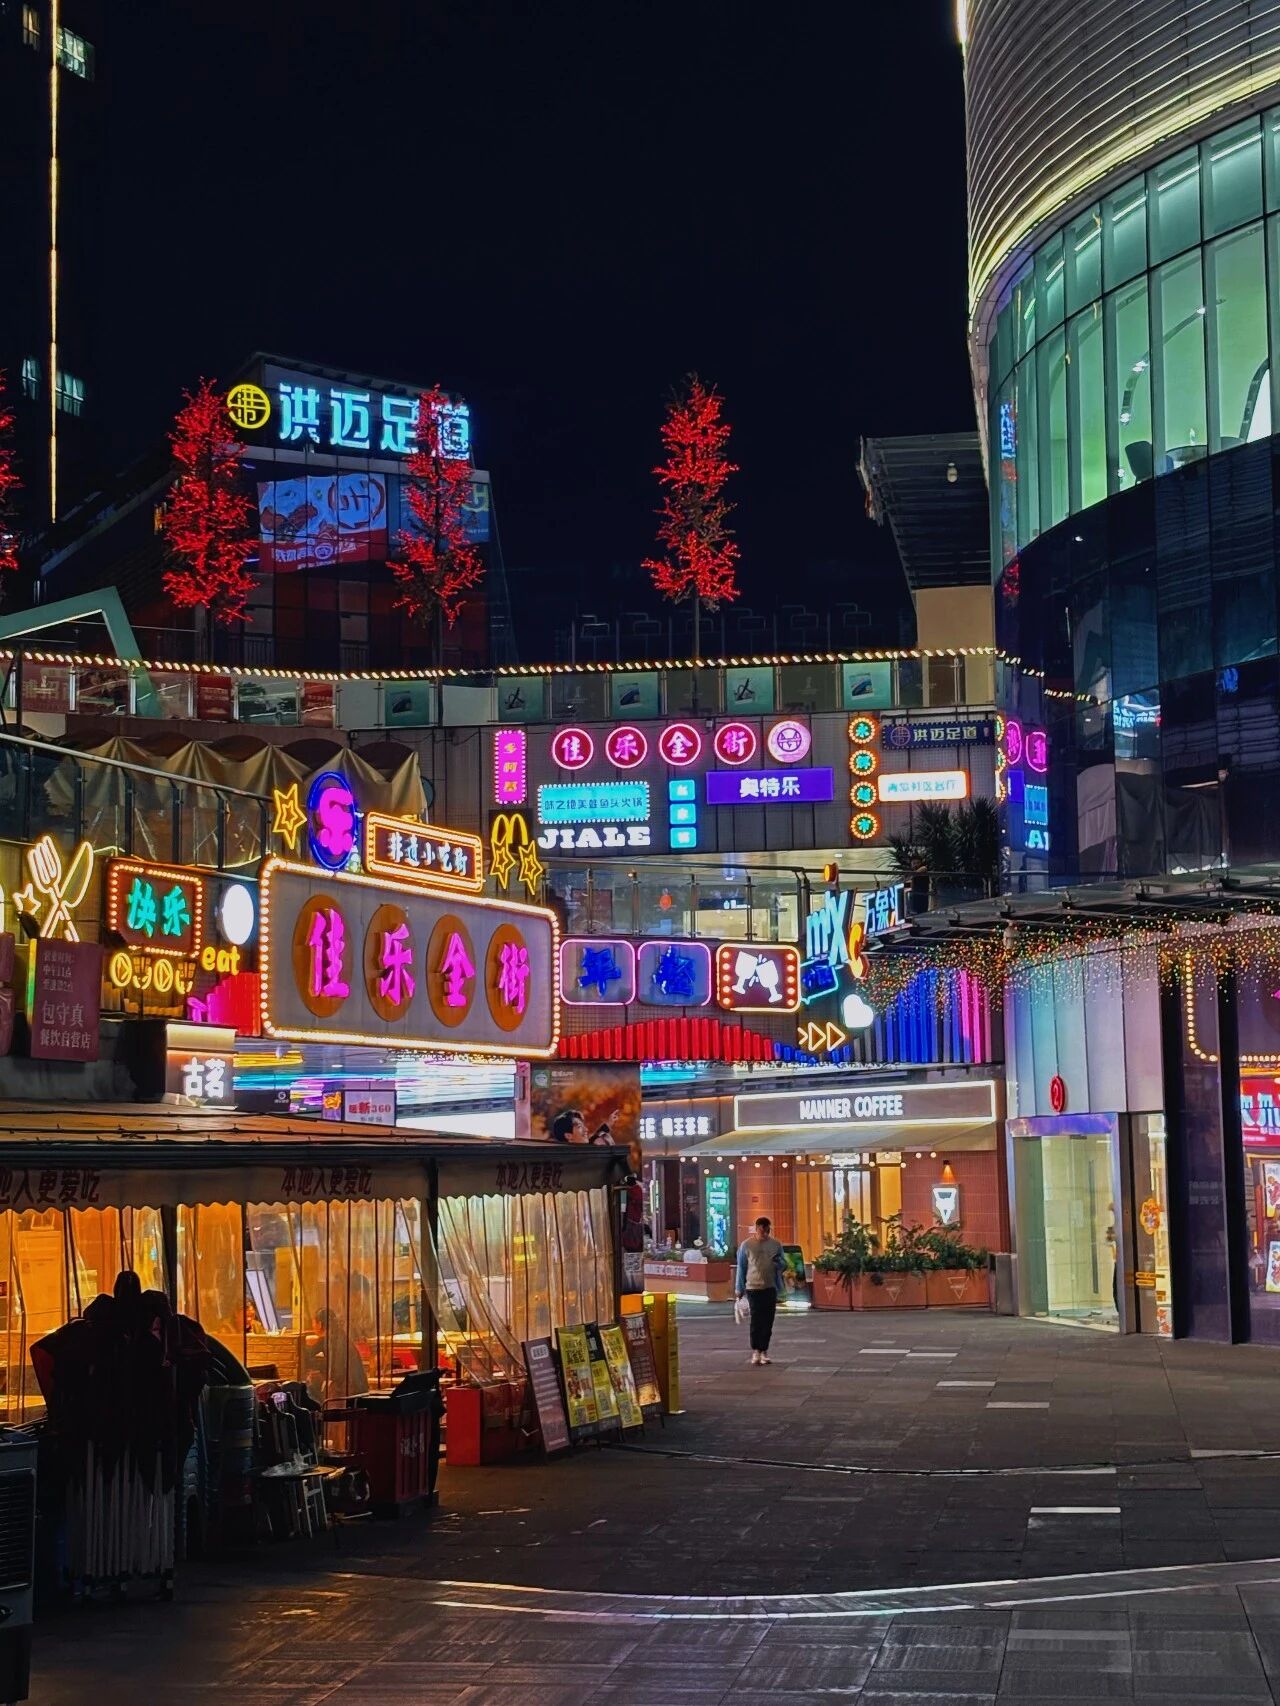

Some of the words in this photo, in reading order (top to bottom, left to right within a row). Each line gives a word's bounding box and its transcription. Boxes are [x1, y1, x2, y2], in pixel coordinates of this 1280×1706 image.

[914, 726, 978, 742] 洪迈足道
[739, 777, 801, 798] 奥特乐
[537, 826, 651, 849] JIALE
[387, 831, 468, 877] 非遗小吃街
[127, 877, 191, 938] 快乐
[201, 946, 241, 976] eat
[42, 1000, 84, 1027] 包守真
[40, 1028, 92, 1050] 餐饮自营店
[180, 1056, 226, 1099] 古茗
[799, 1098, 851, 1121] MANNER
[853, 1095, 904, 1118] COFFEE
